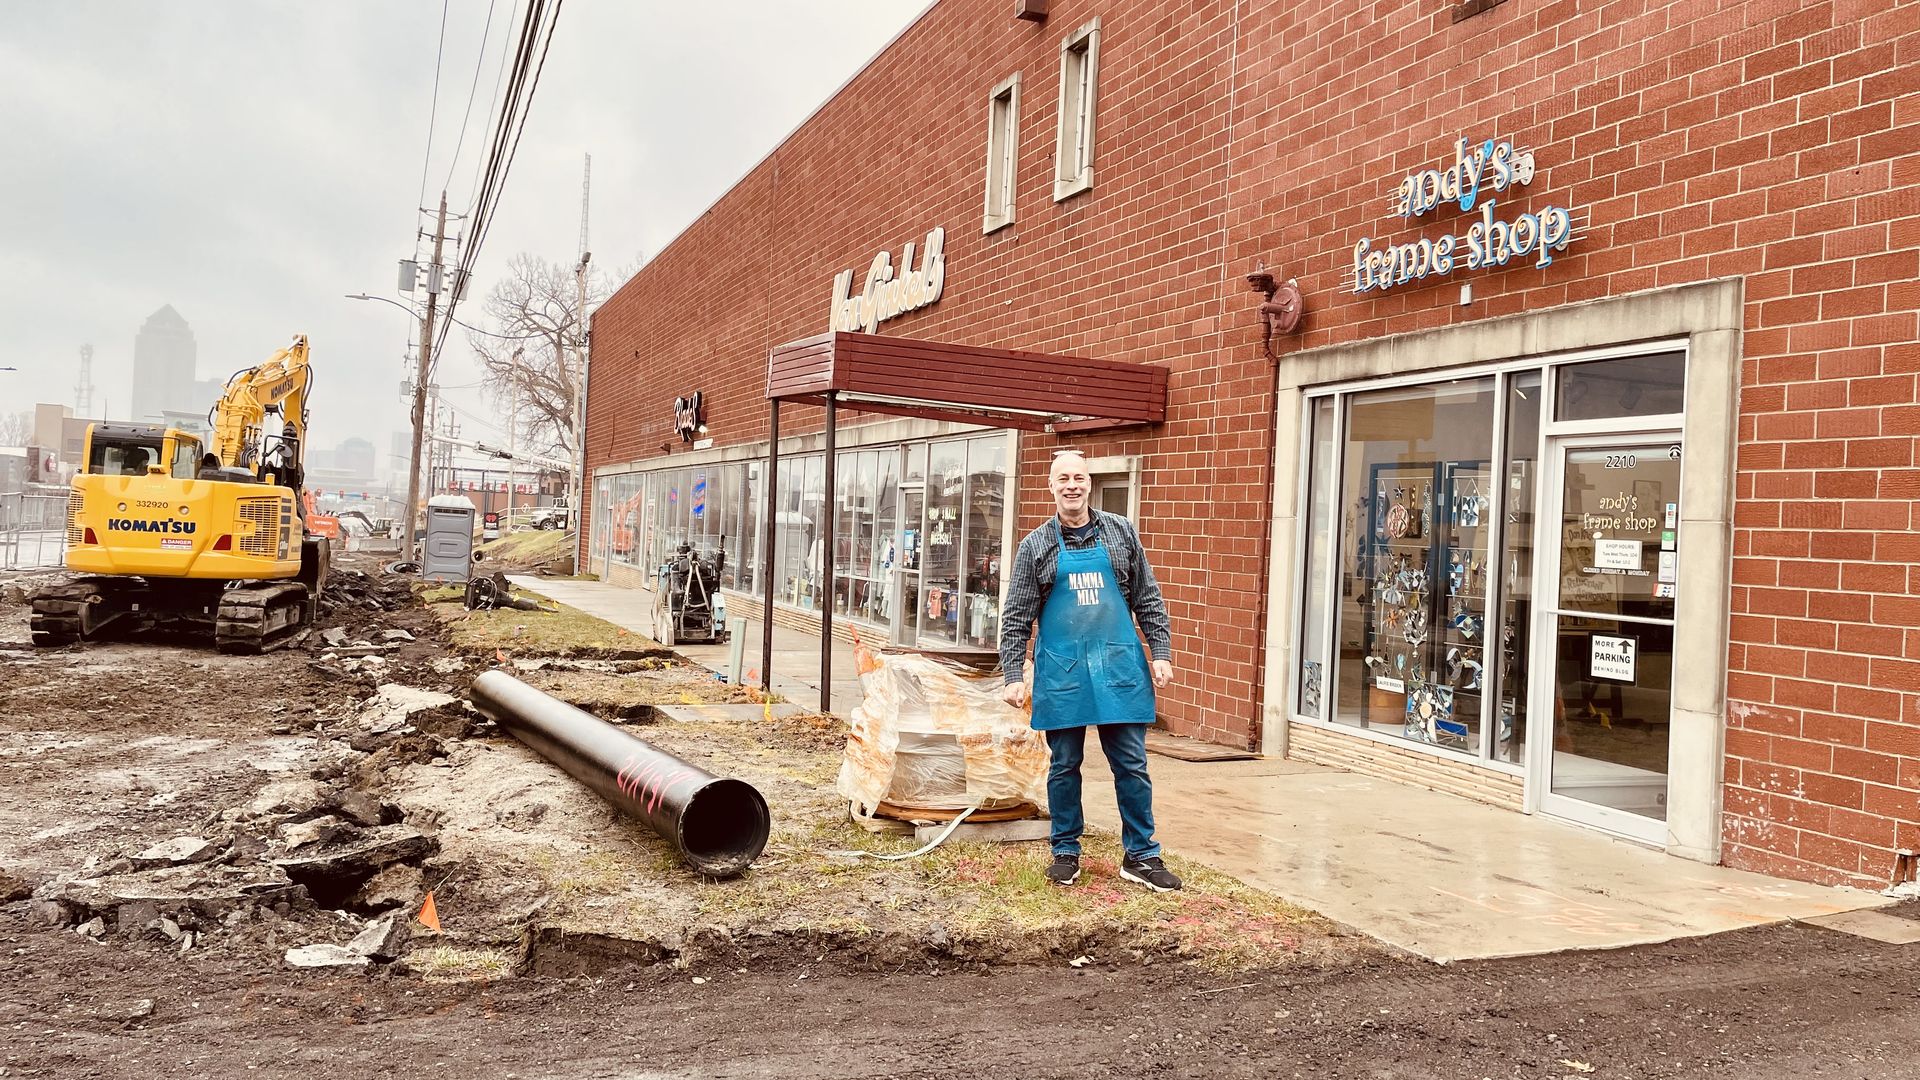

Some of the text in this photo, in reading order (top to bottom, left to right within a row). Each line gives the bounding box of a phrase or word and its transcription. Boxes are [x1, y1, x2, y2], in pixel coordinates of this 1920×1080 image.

[1397, 137, 1513, 217] andy's
[1353, 199, 1570, 294] frame shop
[1605, 455, 1637, 469] 2210
[136, 500, 169, 509] 332920
[1599, 492, 1638, 512] andy's
[108, 518, 196, 534] KOMATSU
[1583, 513, 1621, 530] frame
[1625, 512, 1657, 533] shop
[1068, 572, 1104, 590] MAMMA
[1077, 589, 1099, 606] MIA!
[1595, 640, 1615, 648] MORE
[1594, 652, 1631, 664] PARKING
